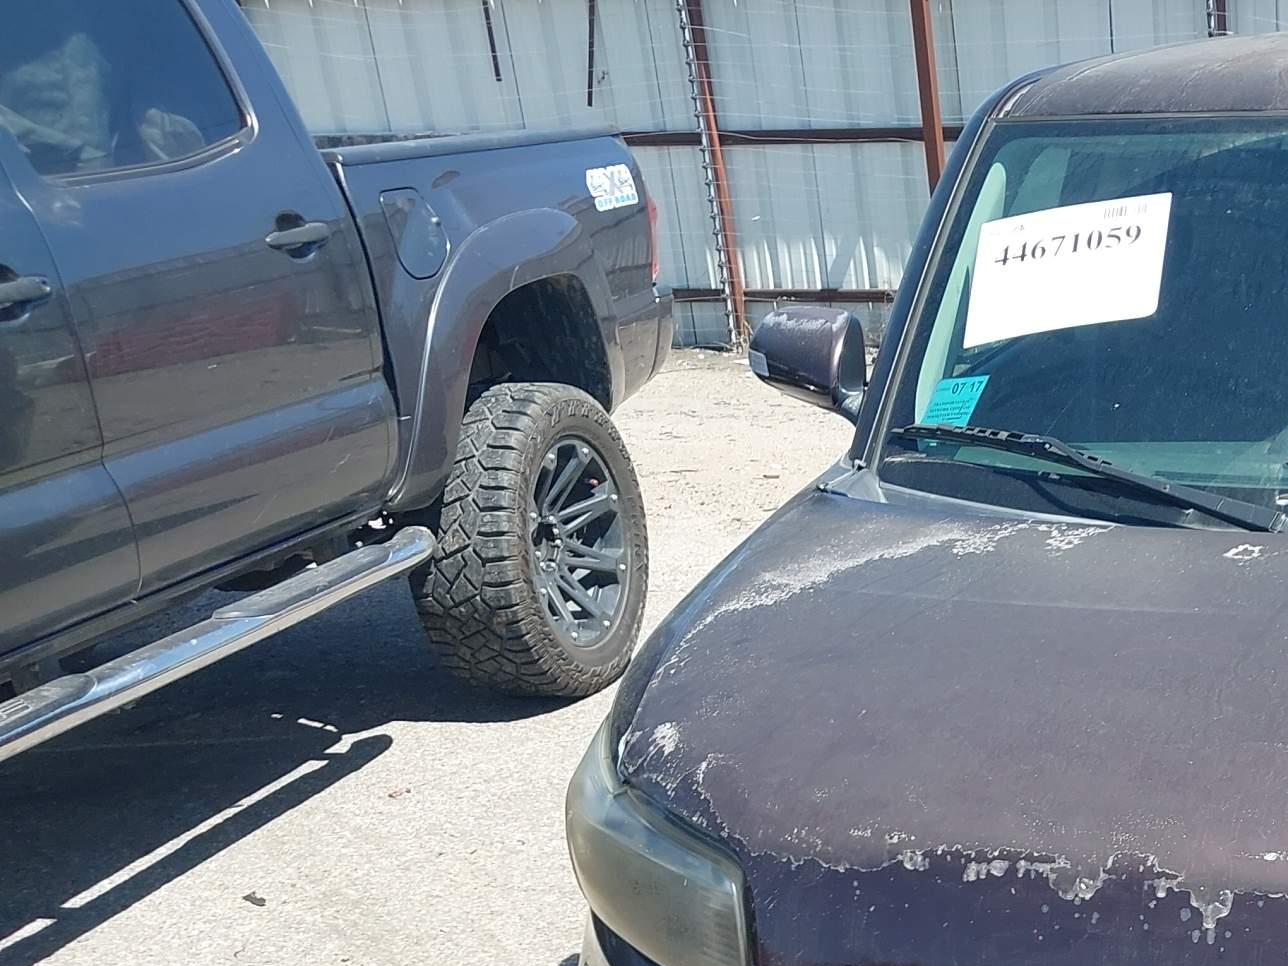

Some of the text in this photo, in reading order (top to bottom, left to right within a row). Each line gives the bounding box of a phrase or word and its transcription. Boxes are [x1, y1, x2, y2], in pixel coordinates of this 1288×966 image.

[995, 225, 1142, 266] 44671059
[951, 382, 968, 395] 07
[969, 380, 984, 393] 17
